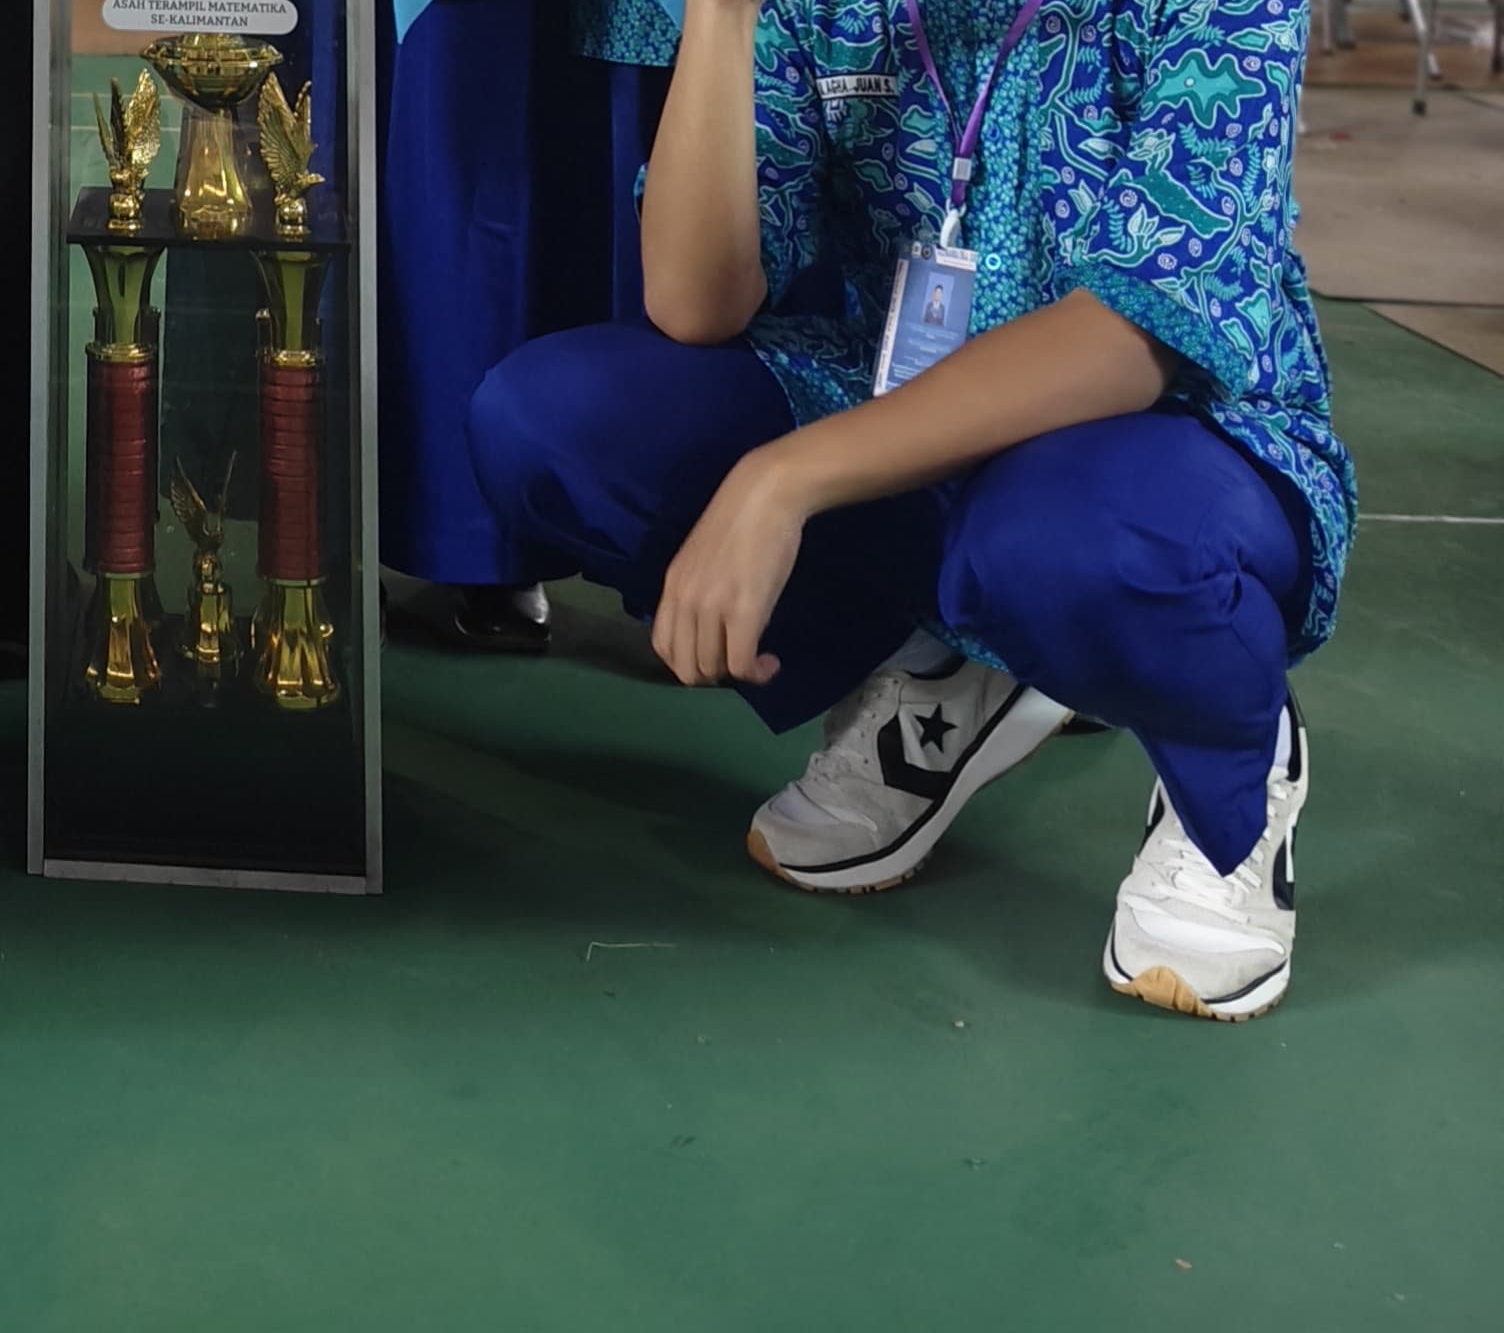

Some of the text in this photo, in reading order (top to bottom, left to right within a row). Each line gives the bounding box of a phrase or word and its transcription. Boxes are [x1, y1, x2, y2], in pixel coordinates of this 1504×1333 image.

[112, 0, 287, 14] ASAH TERAMPIL MATEMATIKA
[150, 14, 248, 27] SE-KALIMANTAN
